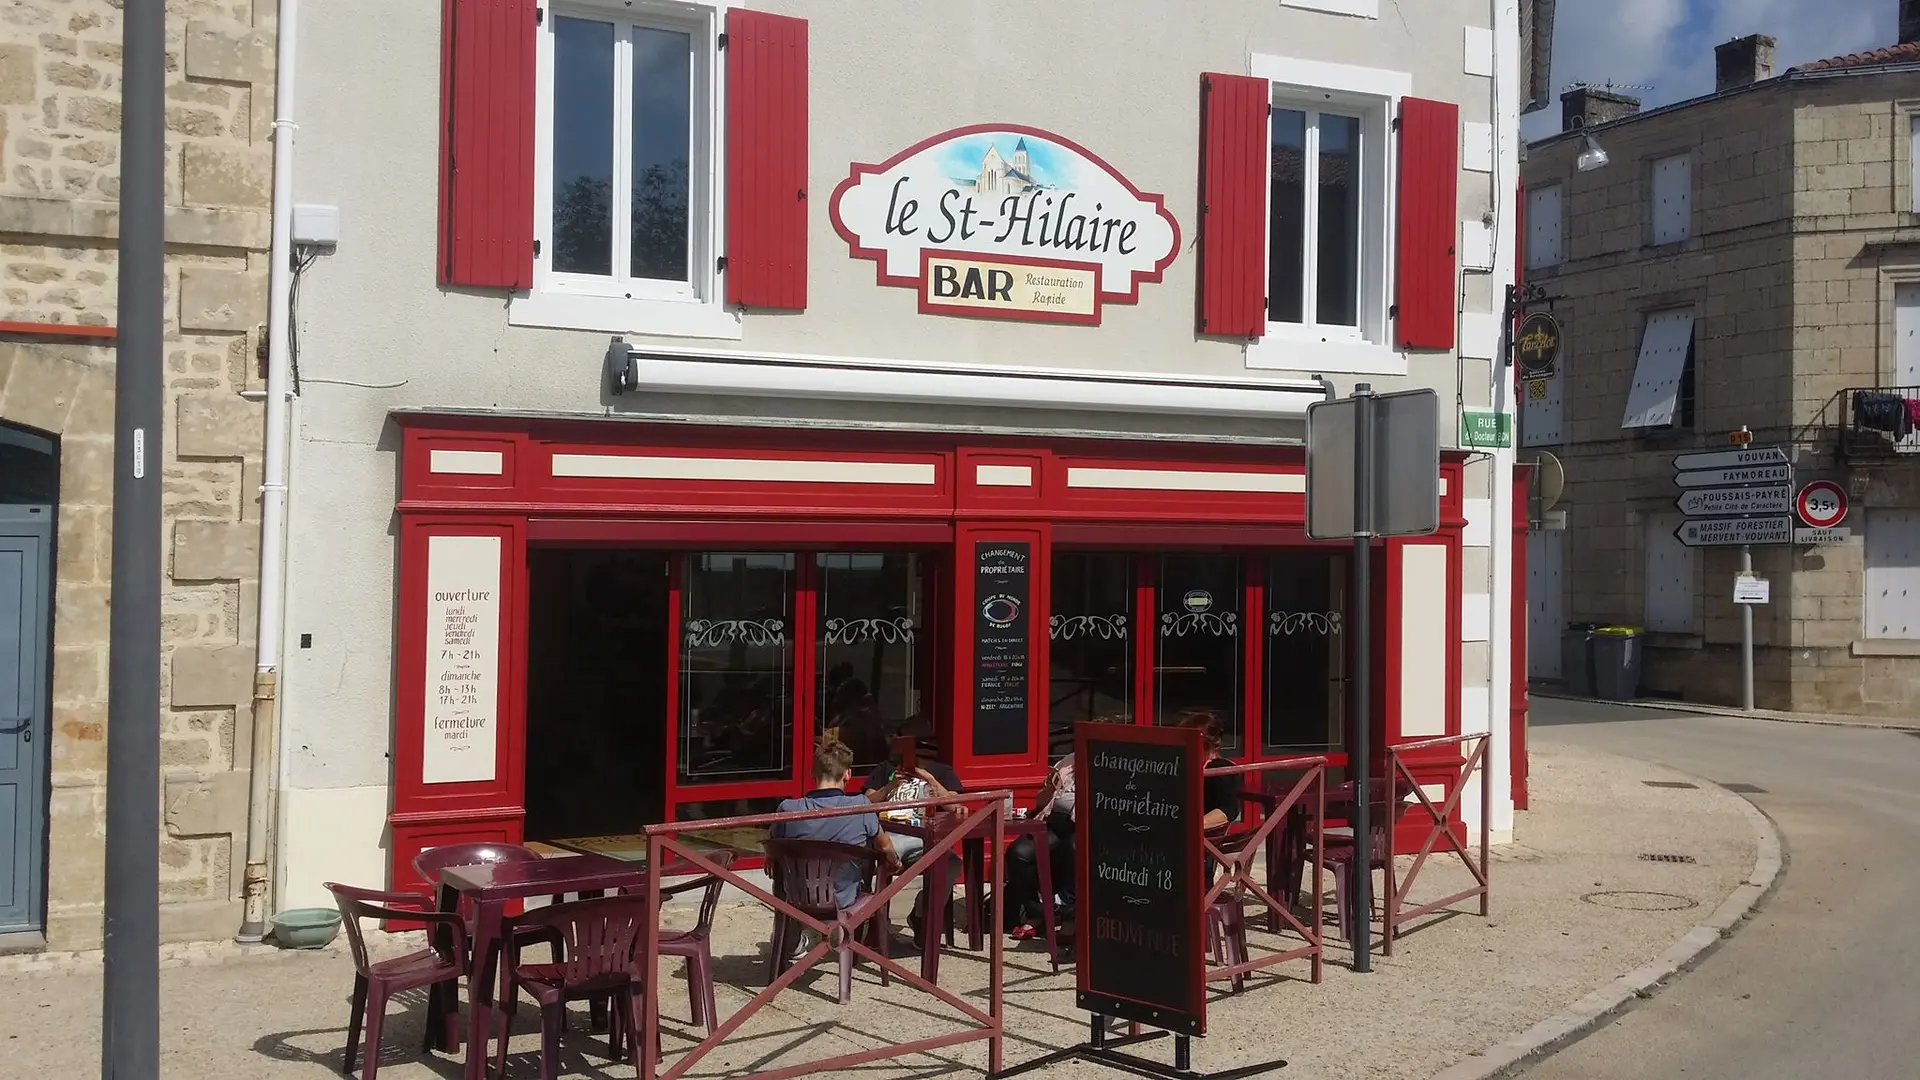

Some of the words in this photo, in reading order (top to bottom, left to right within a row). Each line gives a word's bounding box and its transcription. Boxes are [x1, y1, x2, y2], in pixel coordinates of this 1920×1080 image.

[885, 177, 918, 236] le
[927, 189, 1137, 255] St-Hilaire
[934, 265, 1014, 302] BAR
[1025, 273, 1084, 289] Restauration
[1032, 291, 1066, 306] Rapide
[1478, 418, 1497, 428] RUE
[1737, 451, 1784, 462] VOUVAN
[1723, 469, 1786, 481] FAYMOREAU
[1703, 489, 1787, 501] FOUSSAIS-PAYRÉ
[1703, 503, 1722, 511] Petite
[1724, 502, 1739, 510] Cité
[1740, 502, 1749, 510] de
[1750, 501, 1783, 510] Caractère
[1700, 522, 1732, 532] MASSIF
[1735, 520, 1784, 531] FORESTIER
[1700, 531, 1787, 542] MERVENT-VOUVANT
[980, 549, 1026, 562] CHANGEMENT
[980, 565, 1025, 574] PROPRIÉTAIRE
[435, 588, 490, 602] ouverture
[445, 605, 465, 615] lundi
[445, 614, 478, 623] mercredi
[444, 622, 466, 631] jeudi
[445, 629, 476, 638] vendredi
[444, 637, 471, 646] samedi
[441, 650, 454, 660] 7h
[462, 649, 481, 660] 21h
[440, 670, 482, 681] dimanche
[438, 684, 451, 695] 8h
[461, 684, 477, 695] 13h
[440, 695, 455, 705] 17h
[461, 694, 478, 705] 21h
[434, 716, 486, 730] fermeture
[444, 729, 469, 740] mardi
[1093, 751, 1180, 779] changement
[1125, 781, 1137, 790] de
[1096, 791, 1180, 819] Propriétaire
[1156, 869, 1173, 890] 18
